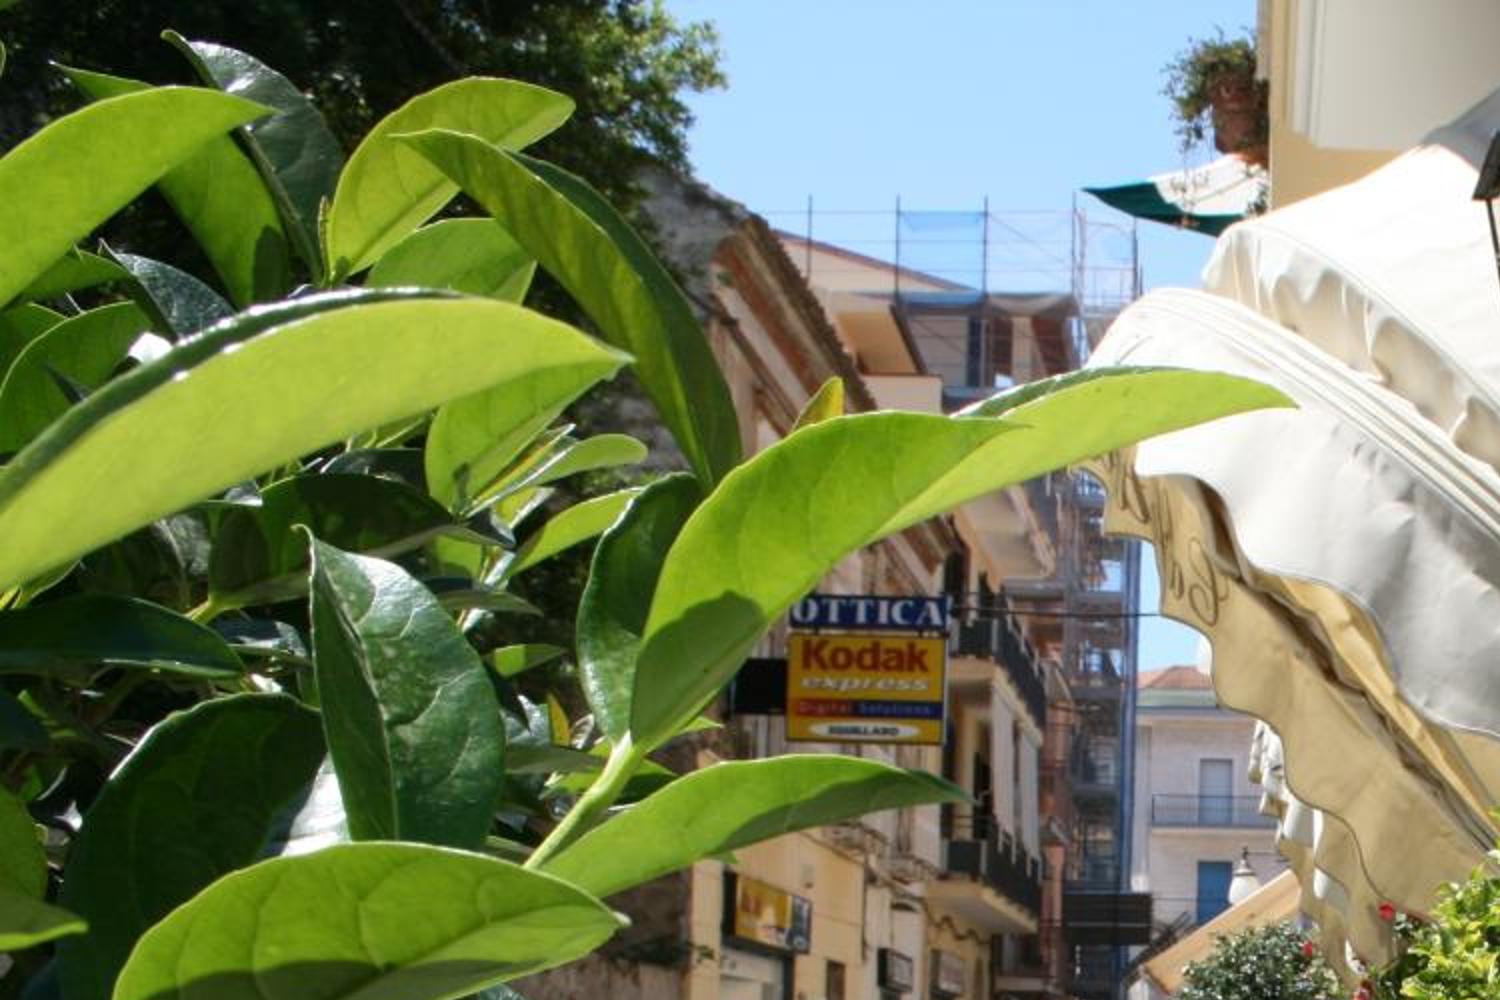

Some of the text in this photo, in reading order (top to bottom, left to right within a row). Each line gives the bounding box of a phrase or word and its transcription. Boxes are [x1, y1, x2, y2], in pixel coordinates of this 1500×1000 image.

[792, 598, 944, 625] OTTICA
[801, 639, 929, 673] Kodak
[800, 677, 929, 692] express
